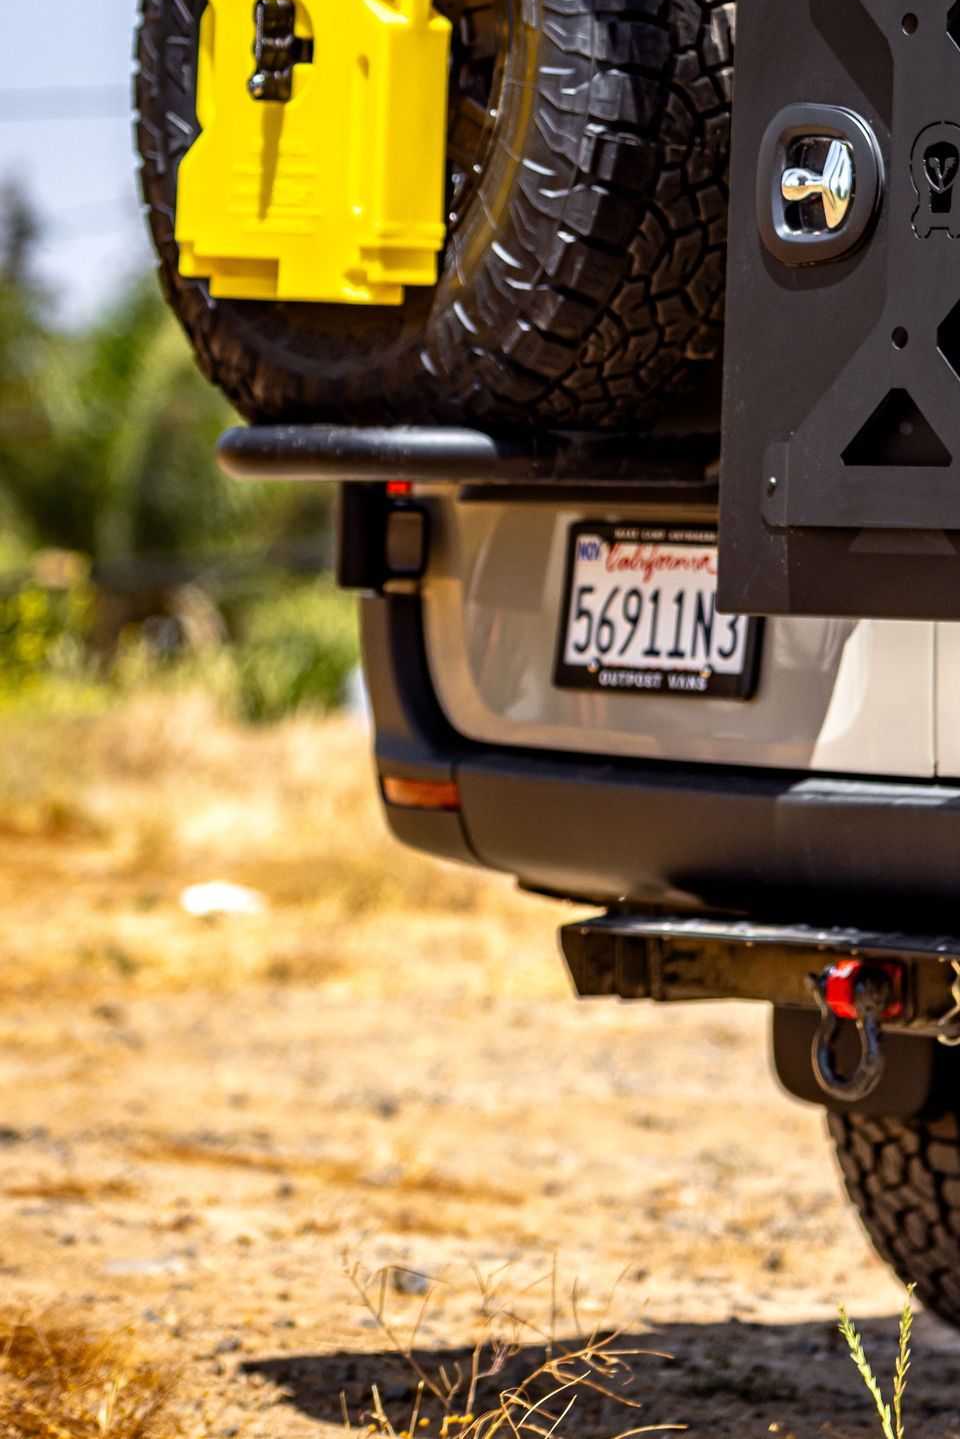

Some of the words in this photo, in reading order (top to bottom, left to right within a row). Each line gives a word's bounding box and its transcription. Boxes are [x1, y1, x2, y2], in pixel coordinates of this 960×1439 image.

[605, 540, 718, 583] California
[573, 584, 740, 659] 56911N3
[599, 670, 662, 688] OUTPOST
[667, 673, 708, 691] VANS
